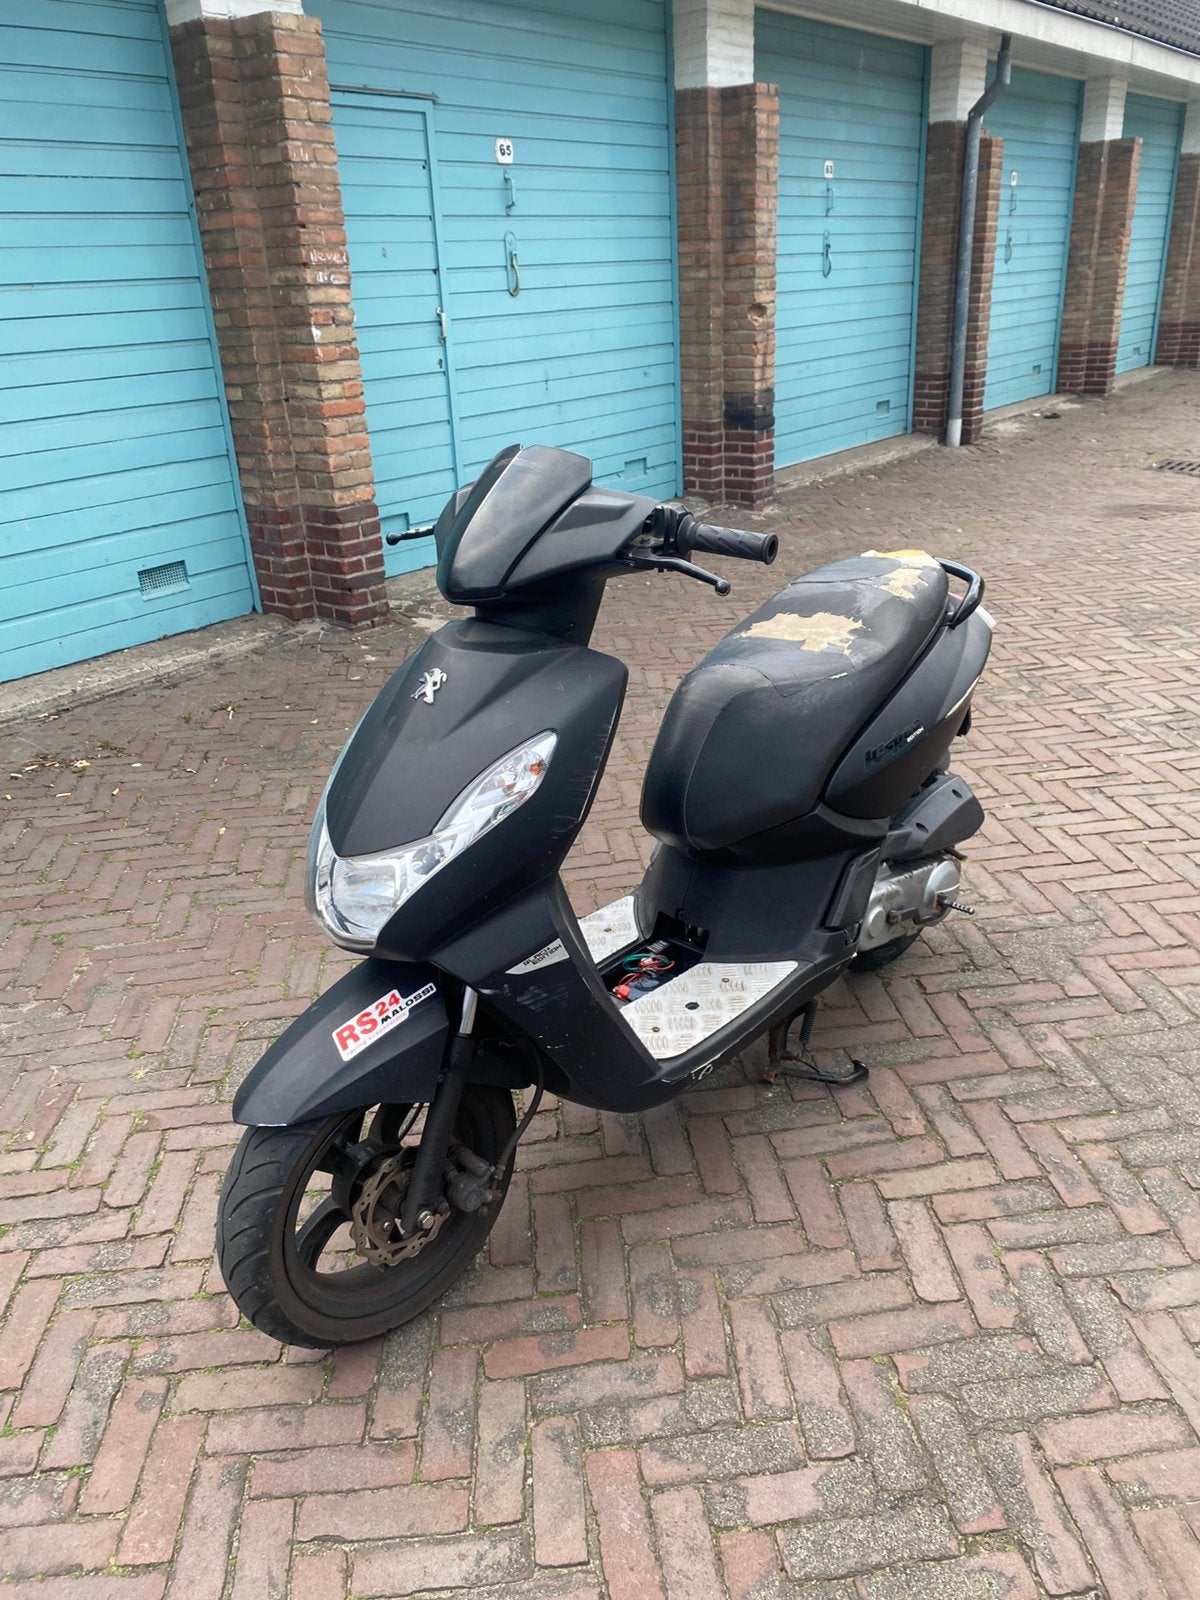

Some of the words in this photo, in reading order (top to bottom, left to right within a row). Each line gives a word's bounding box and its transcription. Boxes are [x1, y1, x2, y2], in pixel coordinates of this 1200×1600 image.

[499, 144, 512, 156] 65
[531, 944, 563, 966] EDITION
[380, 984, 435, 1025] MALOSSI
